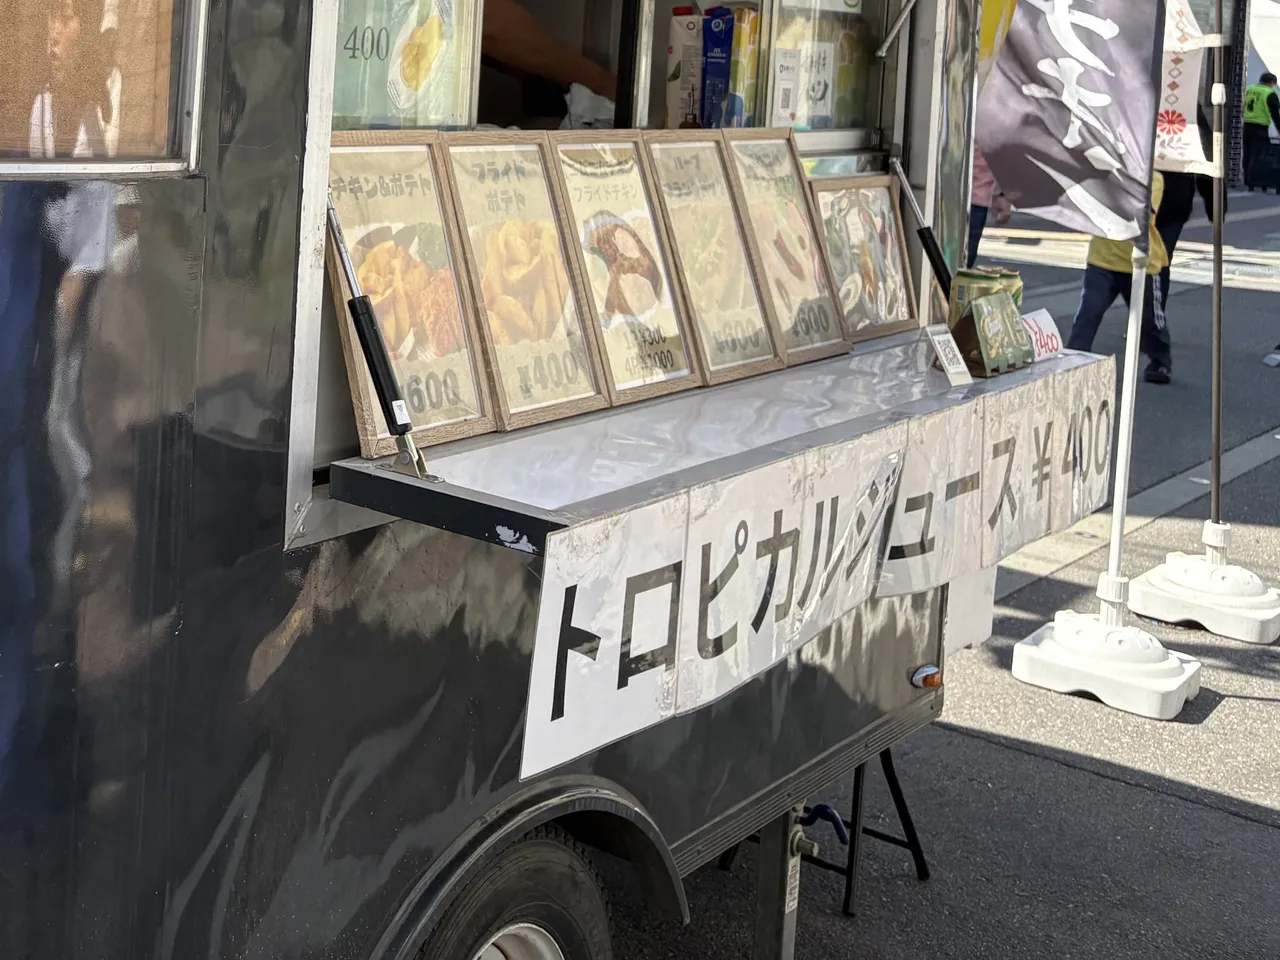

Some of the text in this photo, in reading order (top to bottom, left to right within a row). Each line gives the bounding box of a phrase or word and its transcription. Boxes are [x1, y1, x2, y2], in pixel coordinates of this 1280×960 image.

[331, 173, 431, 200] チキン&ポテト
[399, 367, 460, 414] 600
